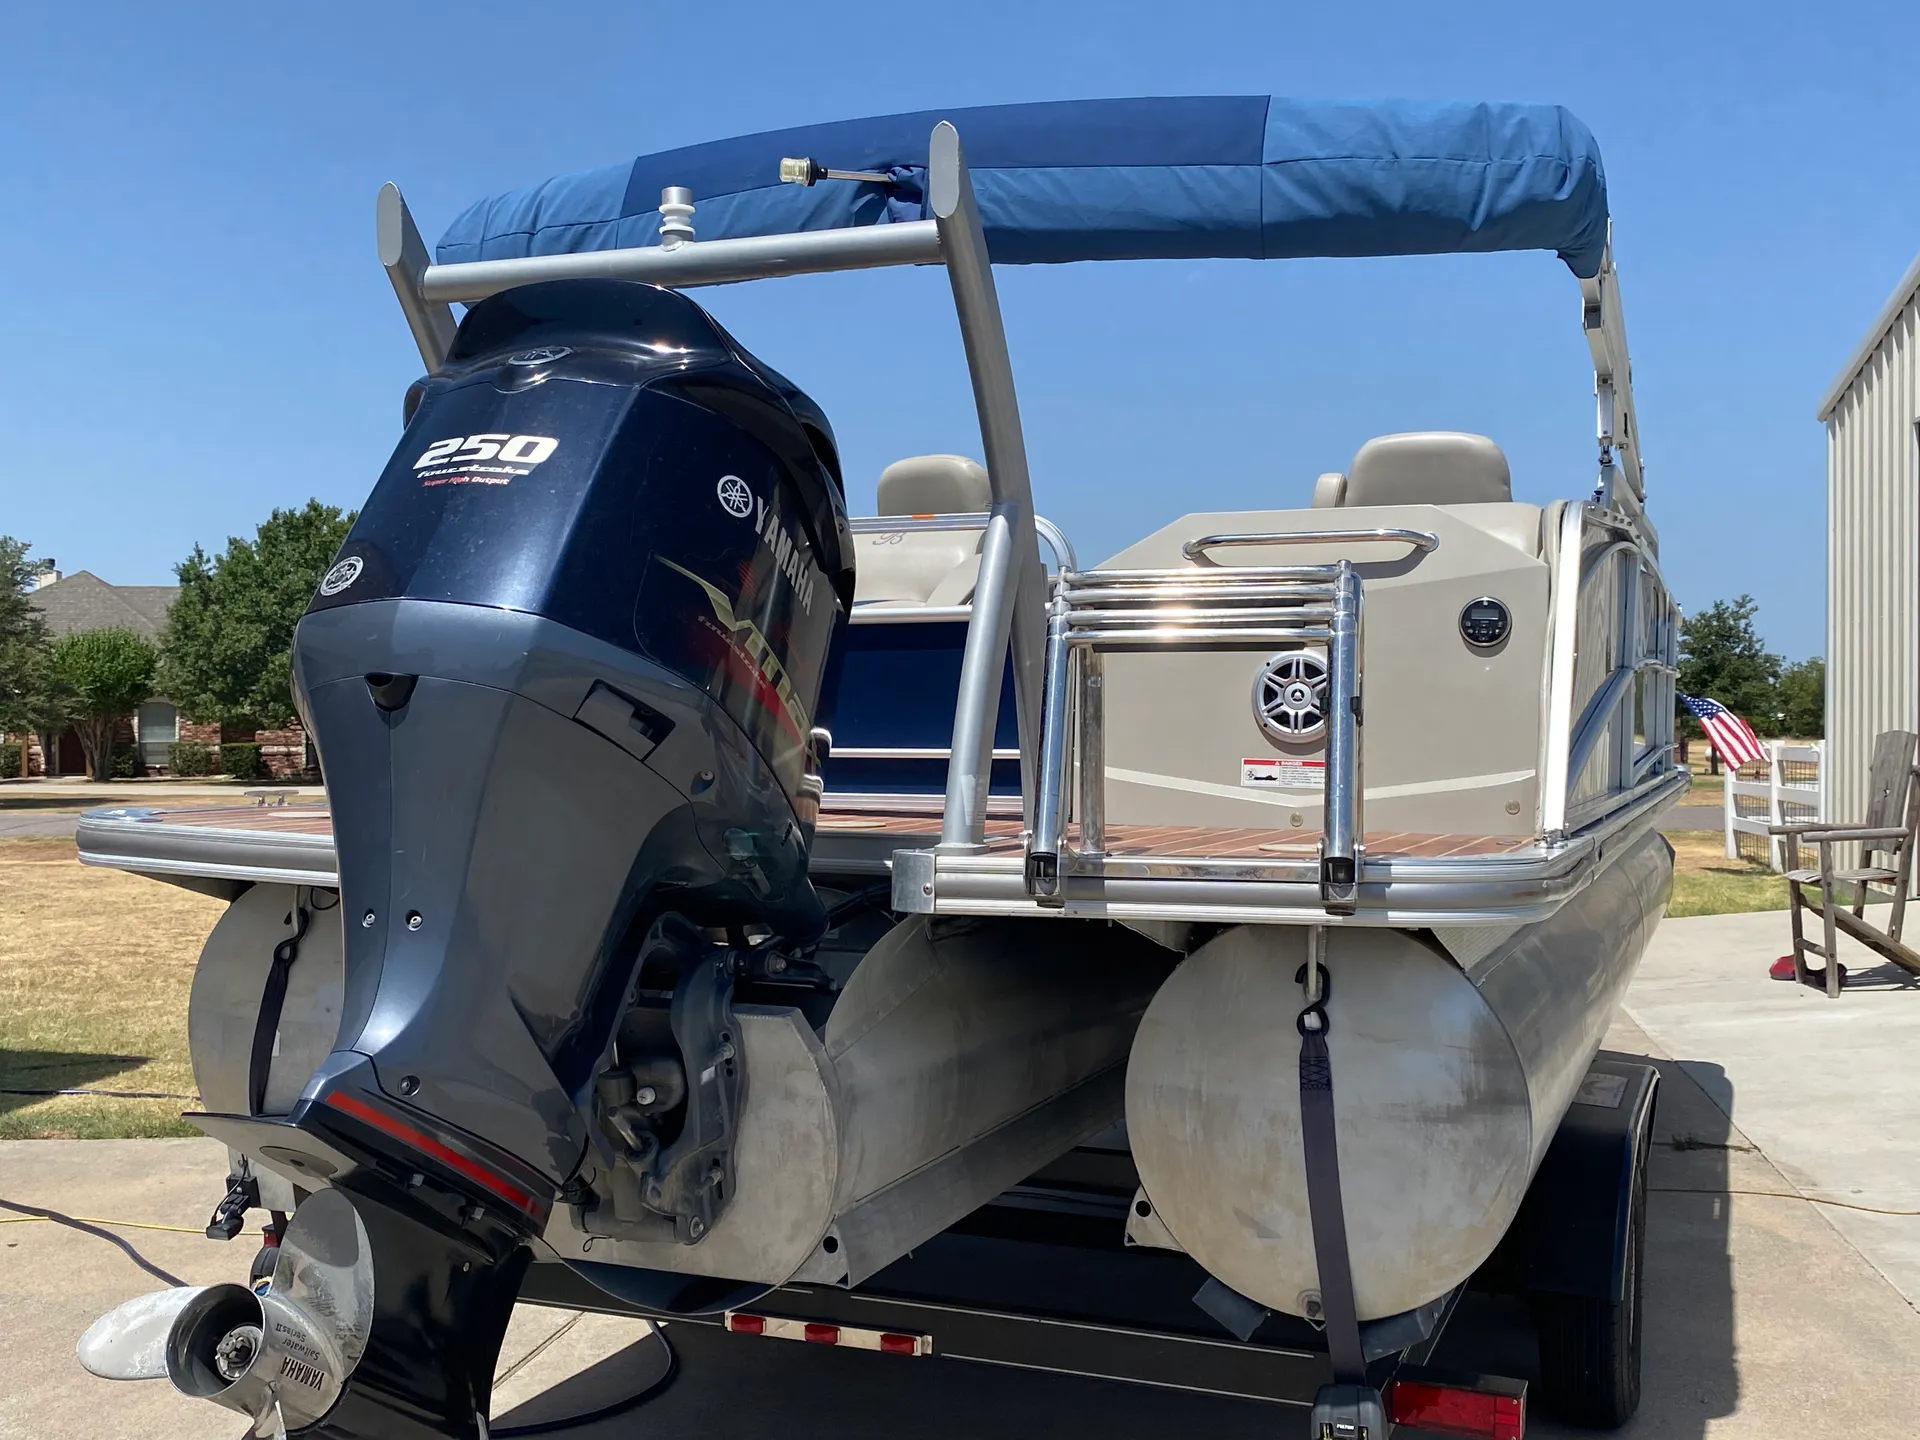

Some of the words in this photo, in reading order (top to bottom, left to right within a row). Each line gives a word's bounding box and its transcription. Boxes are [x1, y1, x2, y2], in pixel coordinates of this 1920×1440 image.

[413, 434, 559, 470] 250
[448, 476, 470, 485] High
[471, 476, 510, 485] Output
[754, 496, 815, 616] YAMAHA
[282, 1338, 320, 1360] Saltwater
[280, 1356, 325, 1391] YAMAHA
